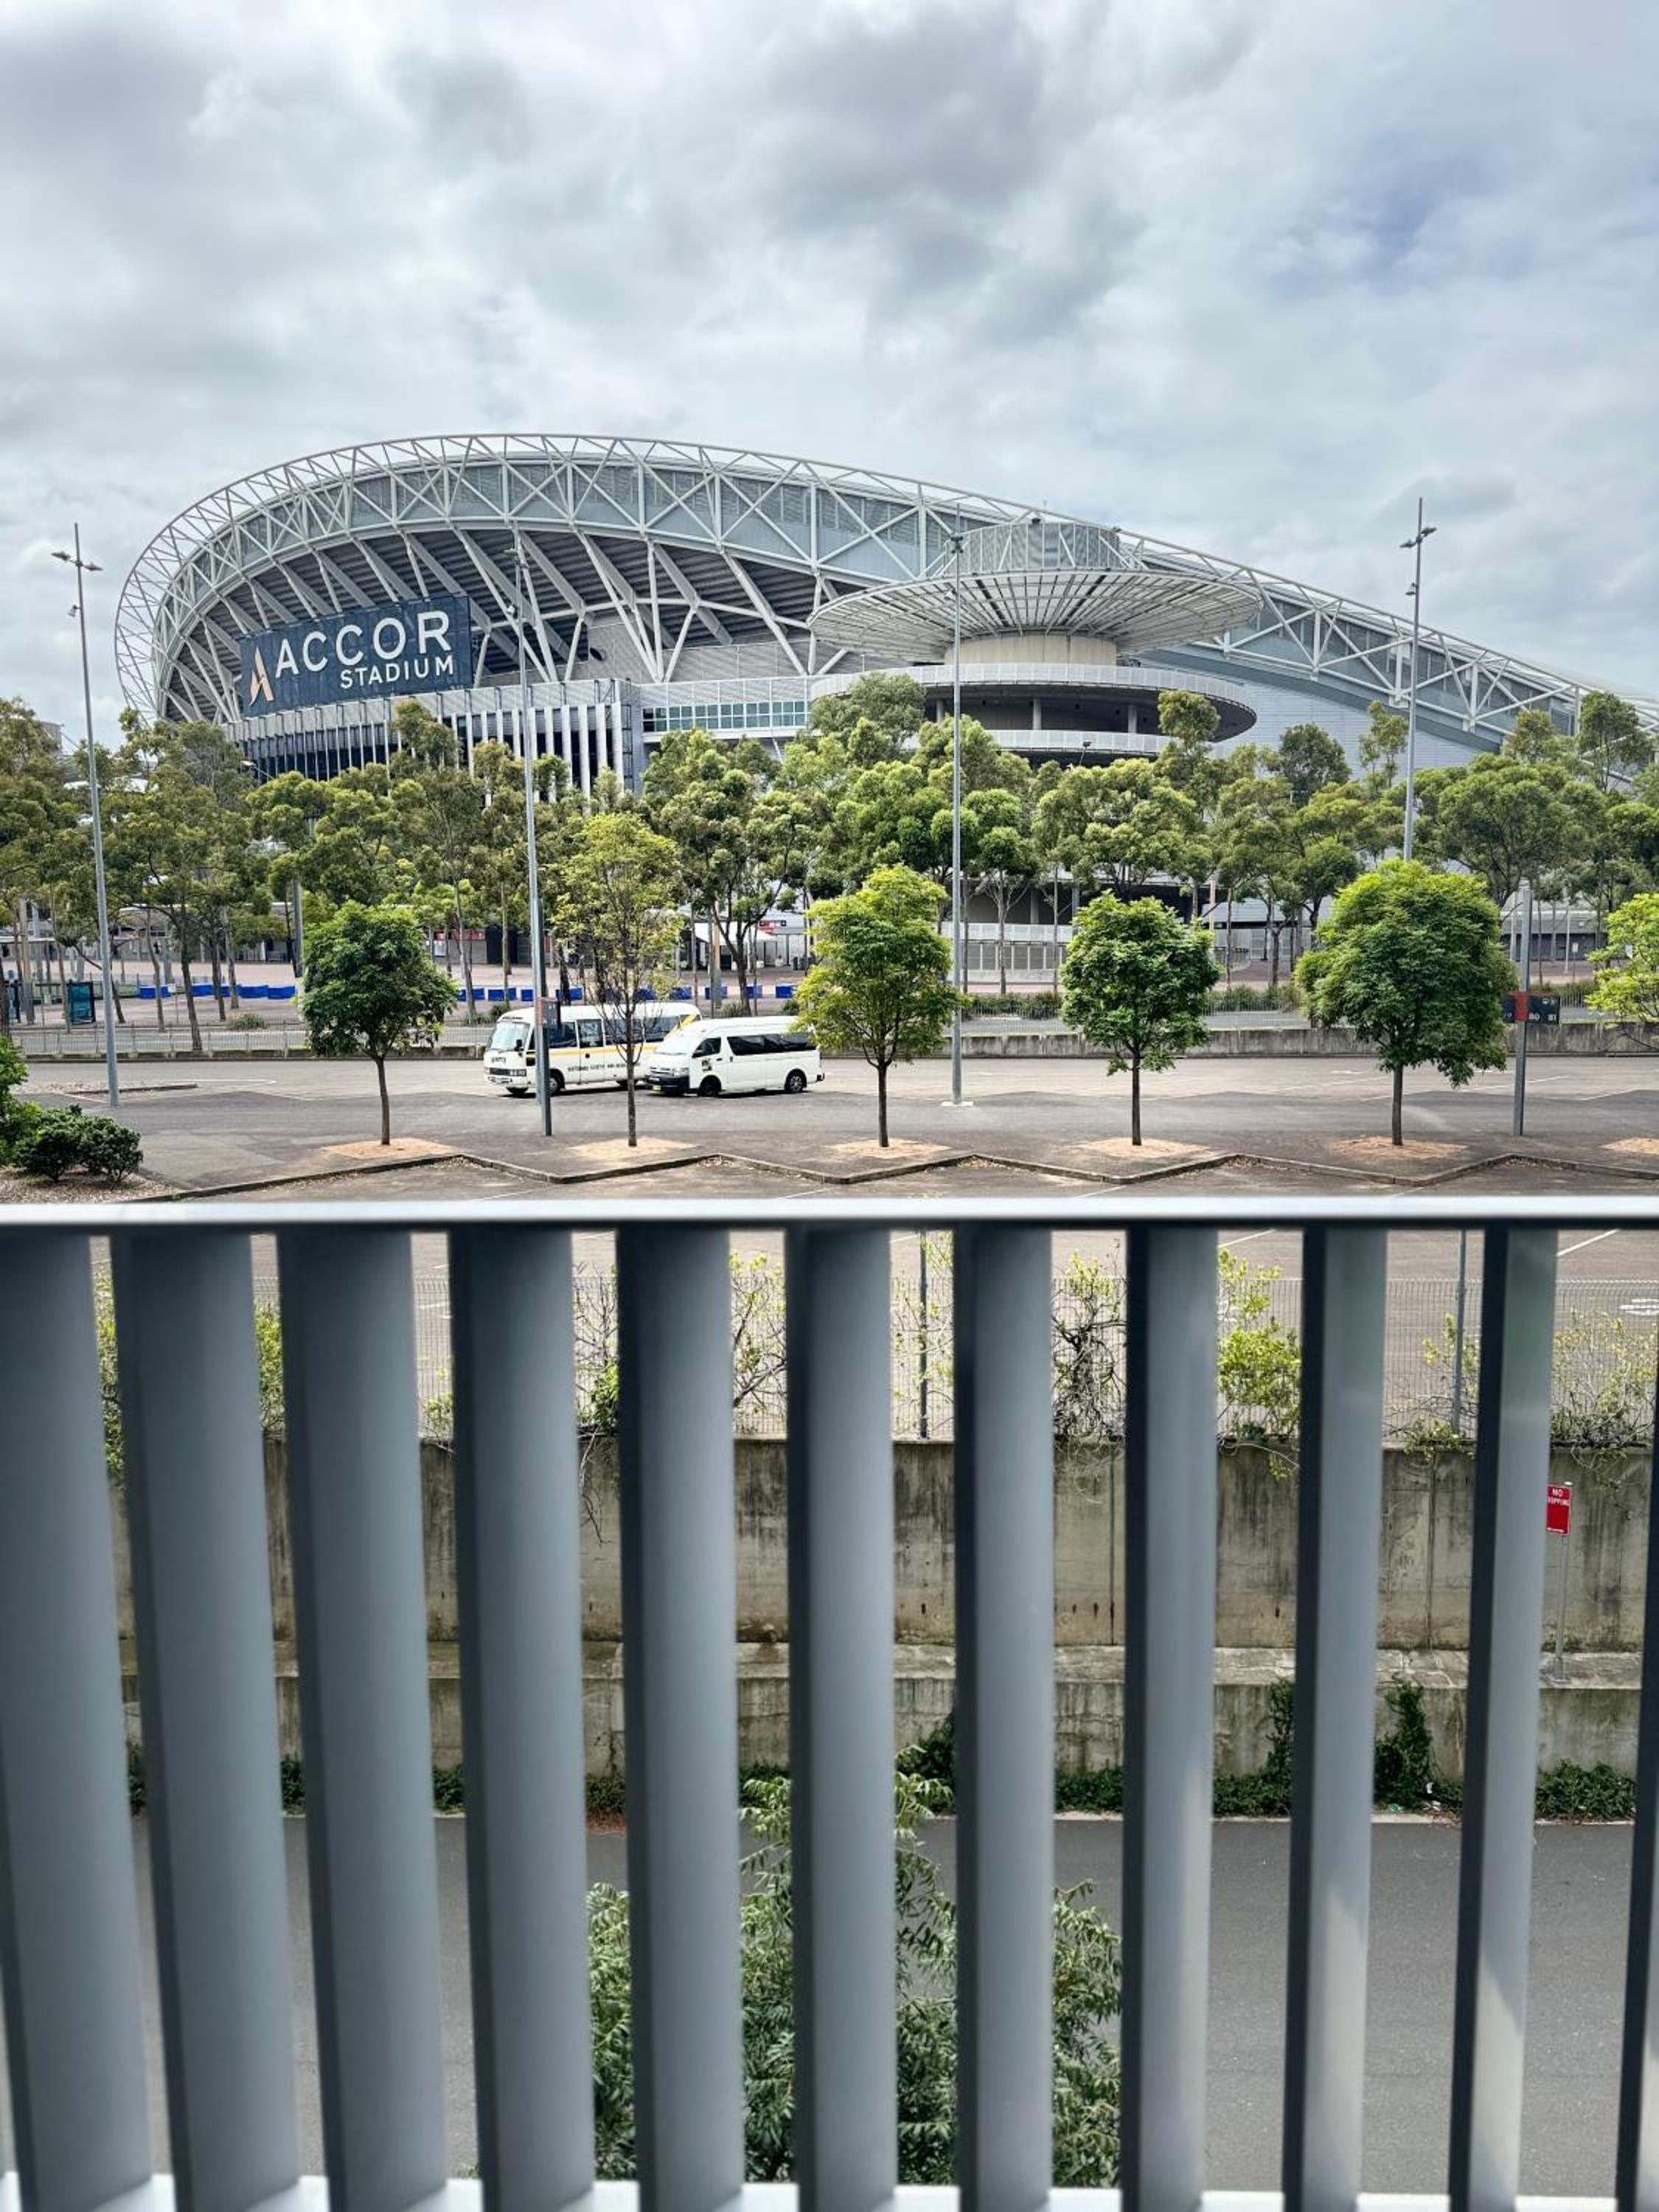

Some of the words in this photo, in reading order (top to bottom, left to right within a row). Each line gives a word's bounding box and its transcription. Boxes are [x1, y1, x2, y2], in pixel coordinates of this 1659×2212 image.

[276, 611, 452, 678] ACCOR
[340, 655, 453, 689] STADIUM
[1552, 1488, 1564, 1498] NO
